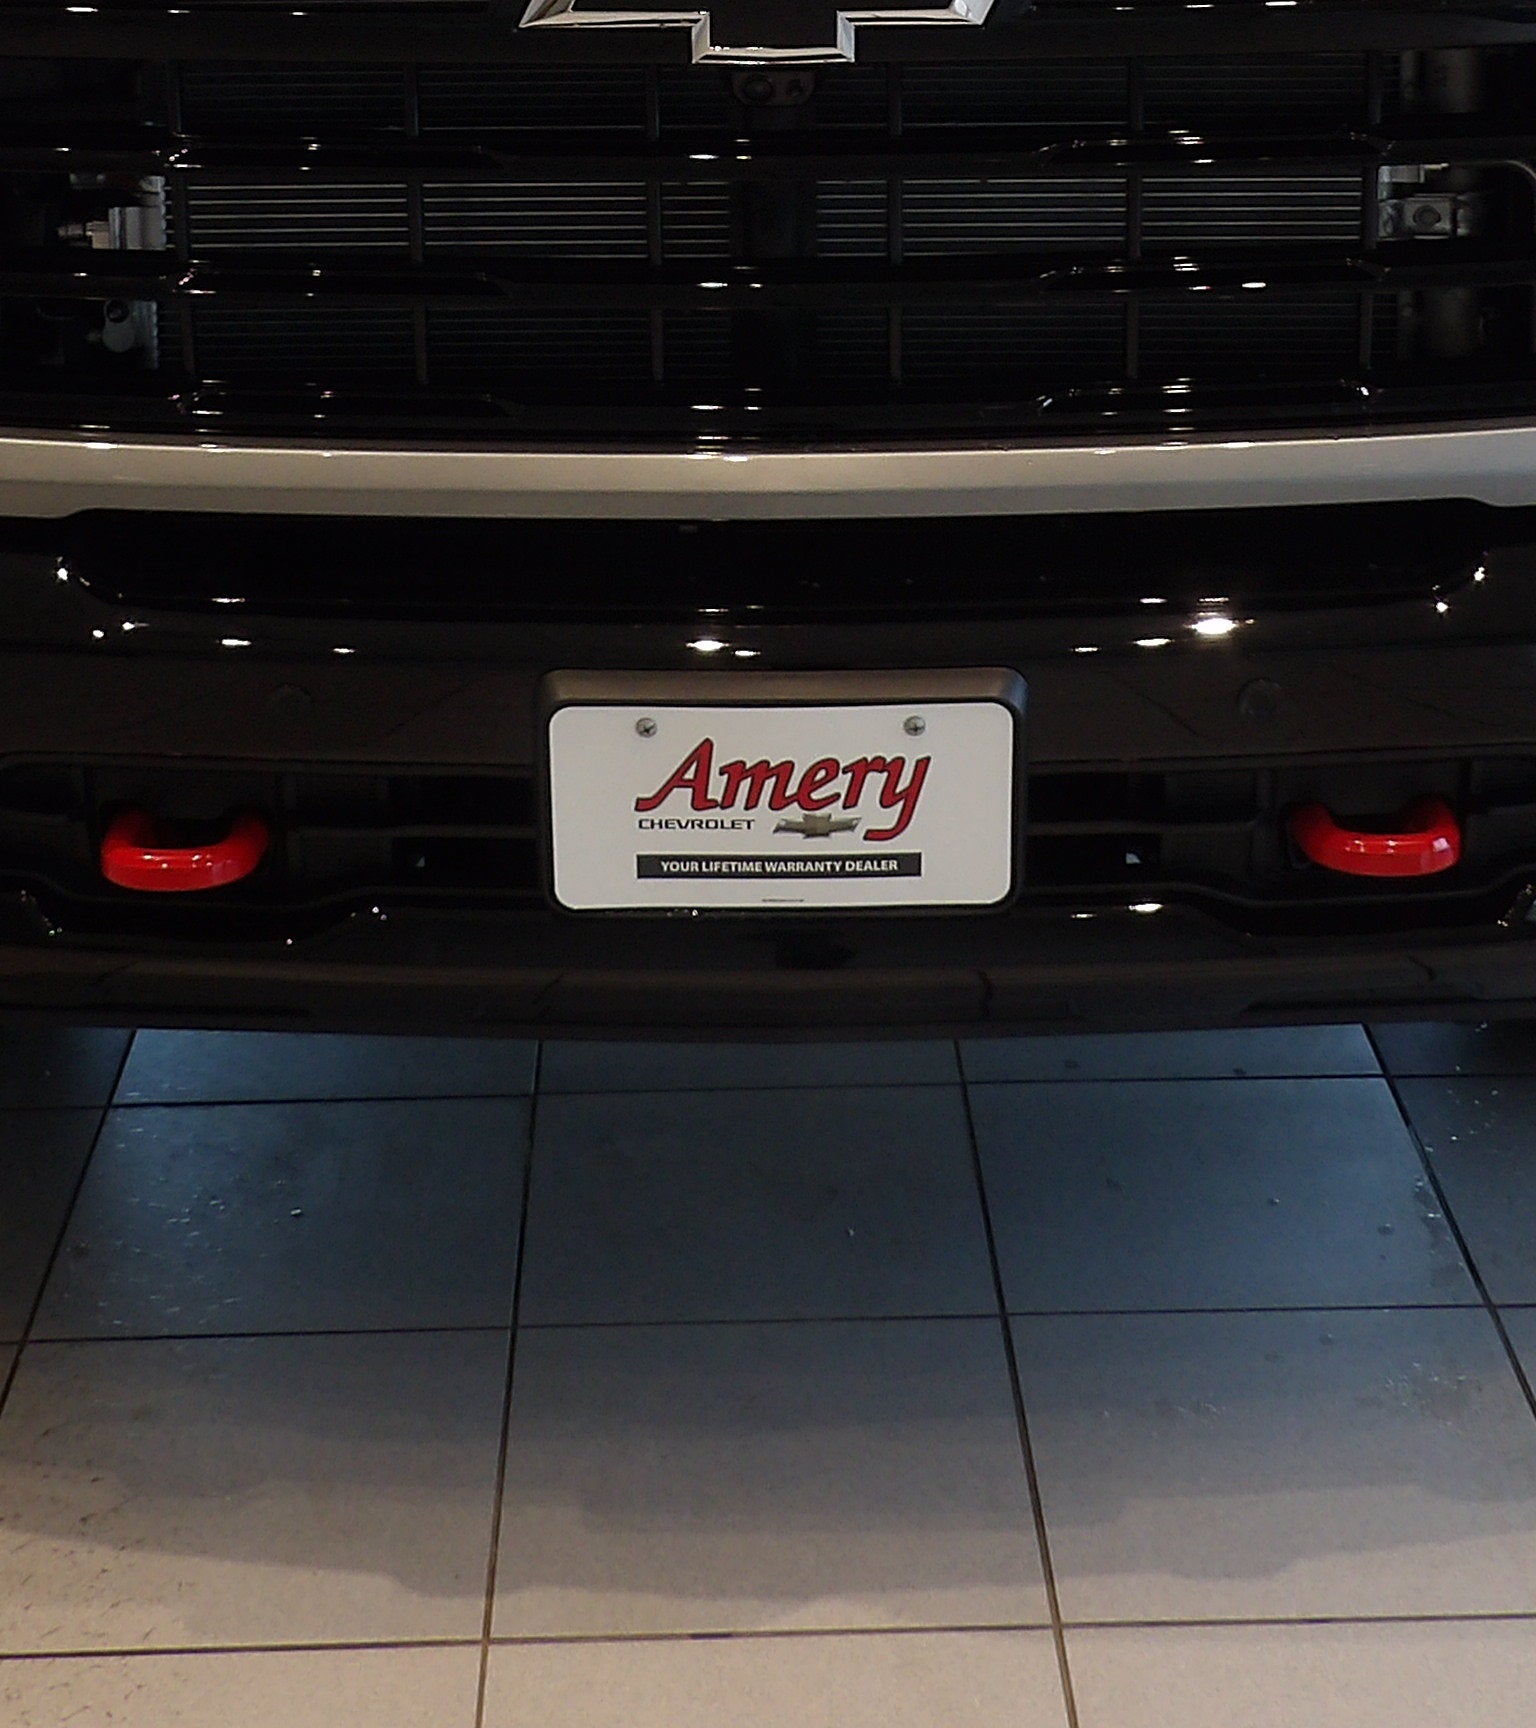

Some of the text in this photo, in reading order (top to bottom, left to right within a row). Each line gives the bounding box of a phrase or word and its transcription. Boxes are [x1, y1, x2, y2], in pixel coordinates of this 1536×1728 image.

[634, 737, 932, 841] Amery
[638, 818, 756, 831] CHEVROLET
[661, 859, 898, 873] YOUR LIFETIME WARRANTY DEALER
